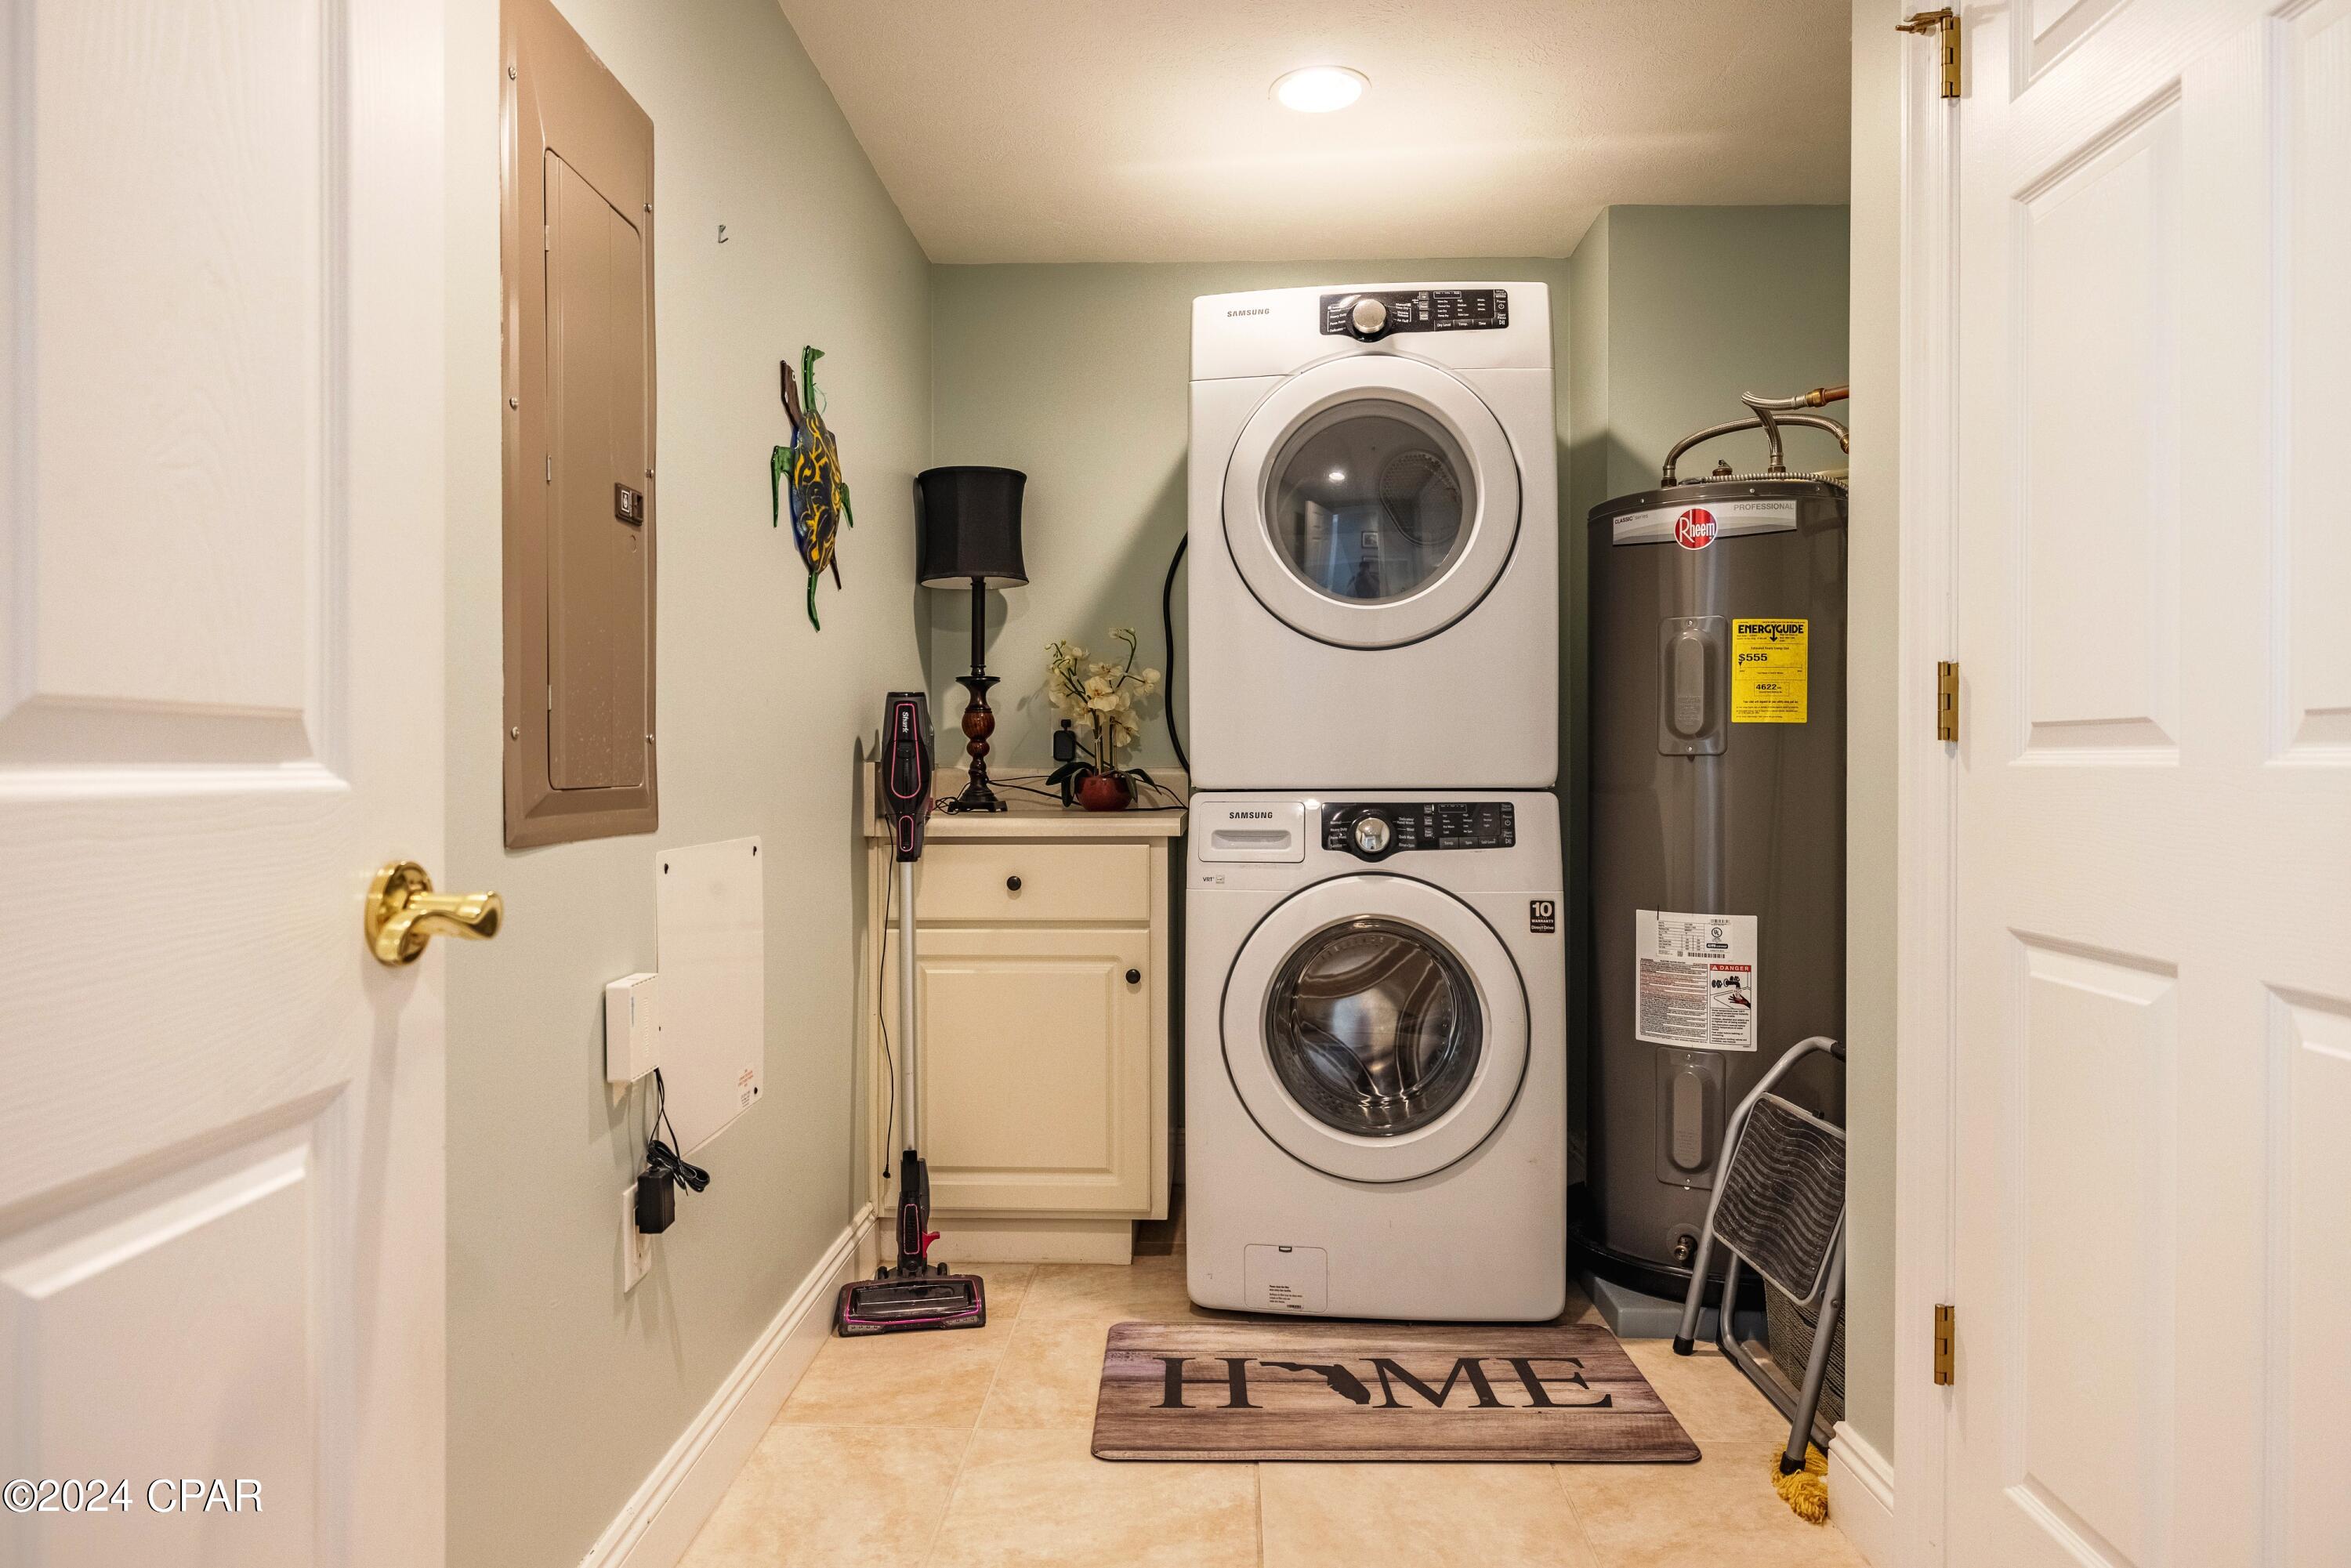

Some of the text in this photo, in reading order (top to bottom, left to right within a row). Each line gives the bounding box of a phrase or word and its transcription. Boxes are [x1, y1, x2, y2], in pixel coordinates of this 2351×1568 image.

[1226, 308, 1270, 317] SAMSUNG
[1733, 502, 1794, 511] PROFESSIONAL
[1679, 509, 1715, 544] Rheem
[1738, 624, 1804, 634] ENERGYGUIDE
[1738, 653, 1768, 662] $555
[1229, 811, 1273, 820] SAMSUNG
[1532, 902, 1552, 917] 10
